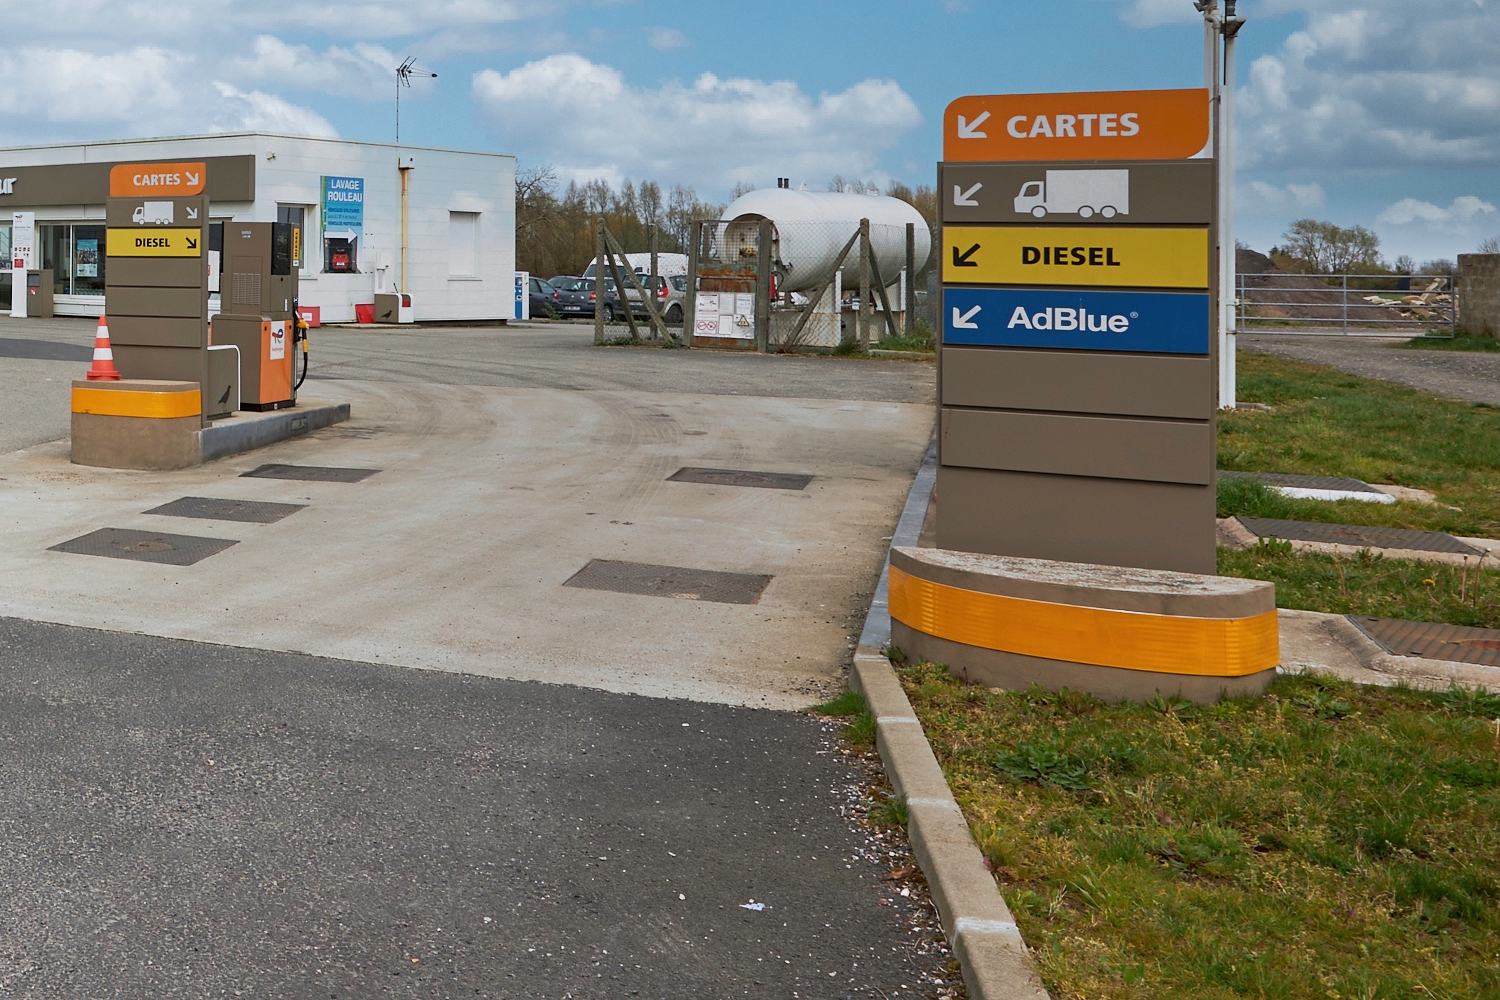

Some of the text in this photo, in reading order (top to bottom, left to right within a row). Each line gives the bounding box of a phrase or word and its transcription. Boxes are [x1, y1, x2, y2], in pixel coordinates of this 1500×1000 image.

[1006, 113, 1140, 138] CARTES
[133, 173, 181, 187] CARTES
[331, 179, 359, 190] LAVAGE
[328, 191, 362, 202] ROULEAU
[135, 238, 170, 247] DIESEL
[1022, 246, 1121, 266] DIESEL
